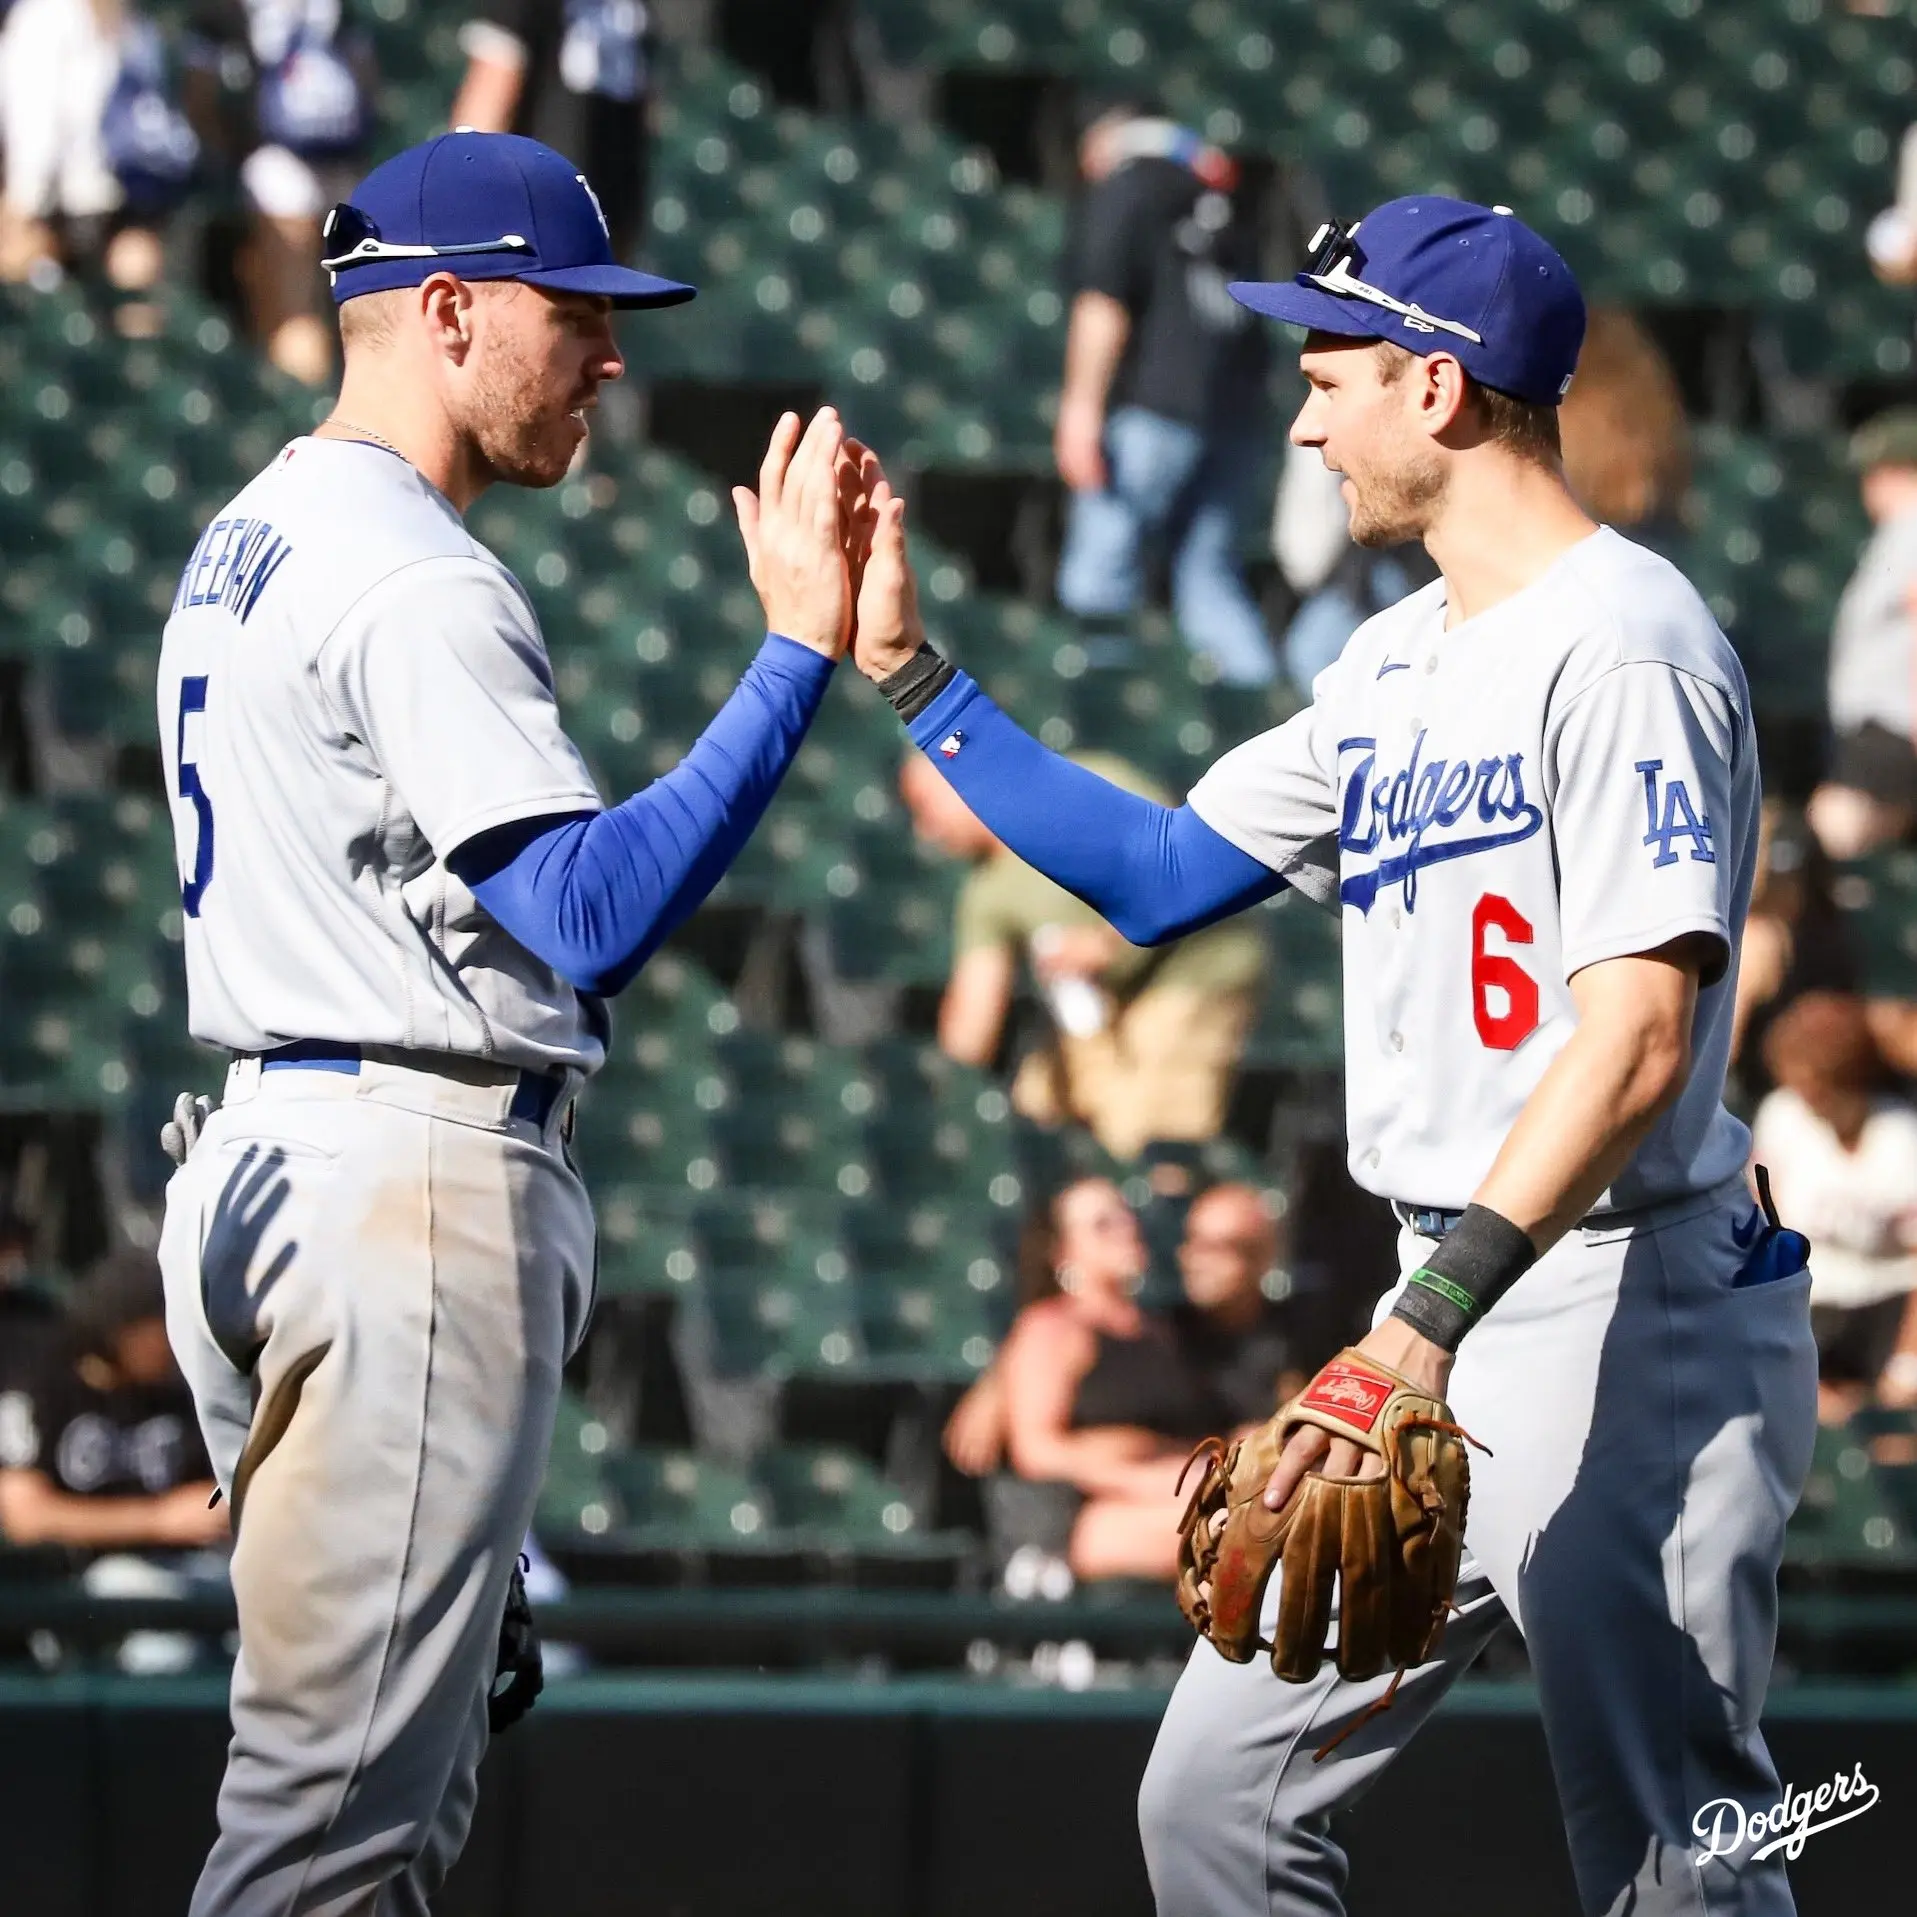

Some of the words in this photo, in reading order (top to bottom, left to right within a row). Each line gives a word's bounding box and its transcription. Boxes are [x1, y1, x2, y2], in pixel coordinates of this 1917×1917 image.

[178, 674, 214, 918] 5
[1337, 728, 1543, 917] Dodgers
[1635, 759, 1716, 869] LA
[1472, 892, 1539, 1050] 6
